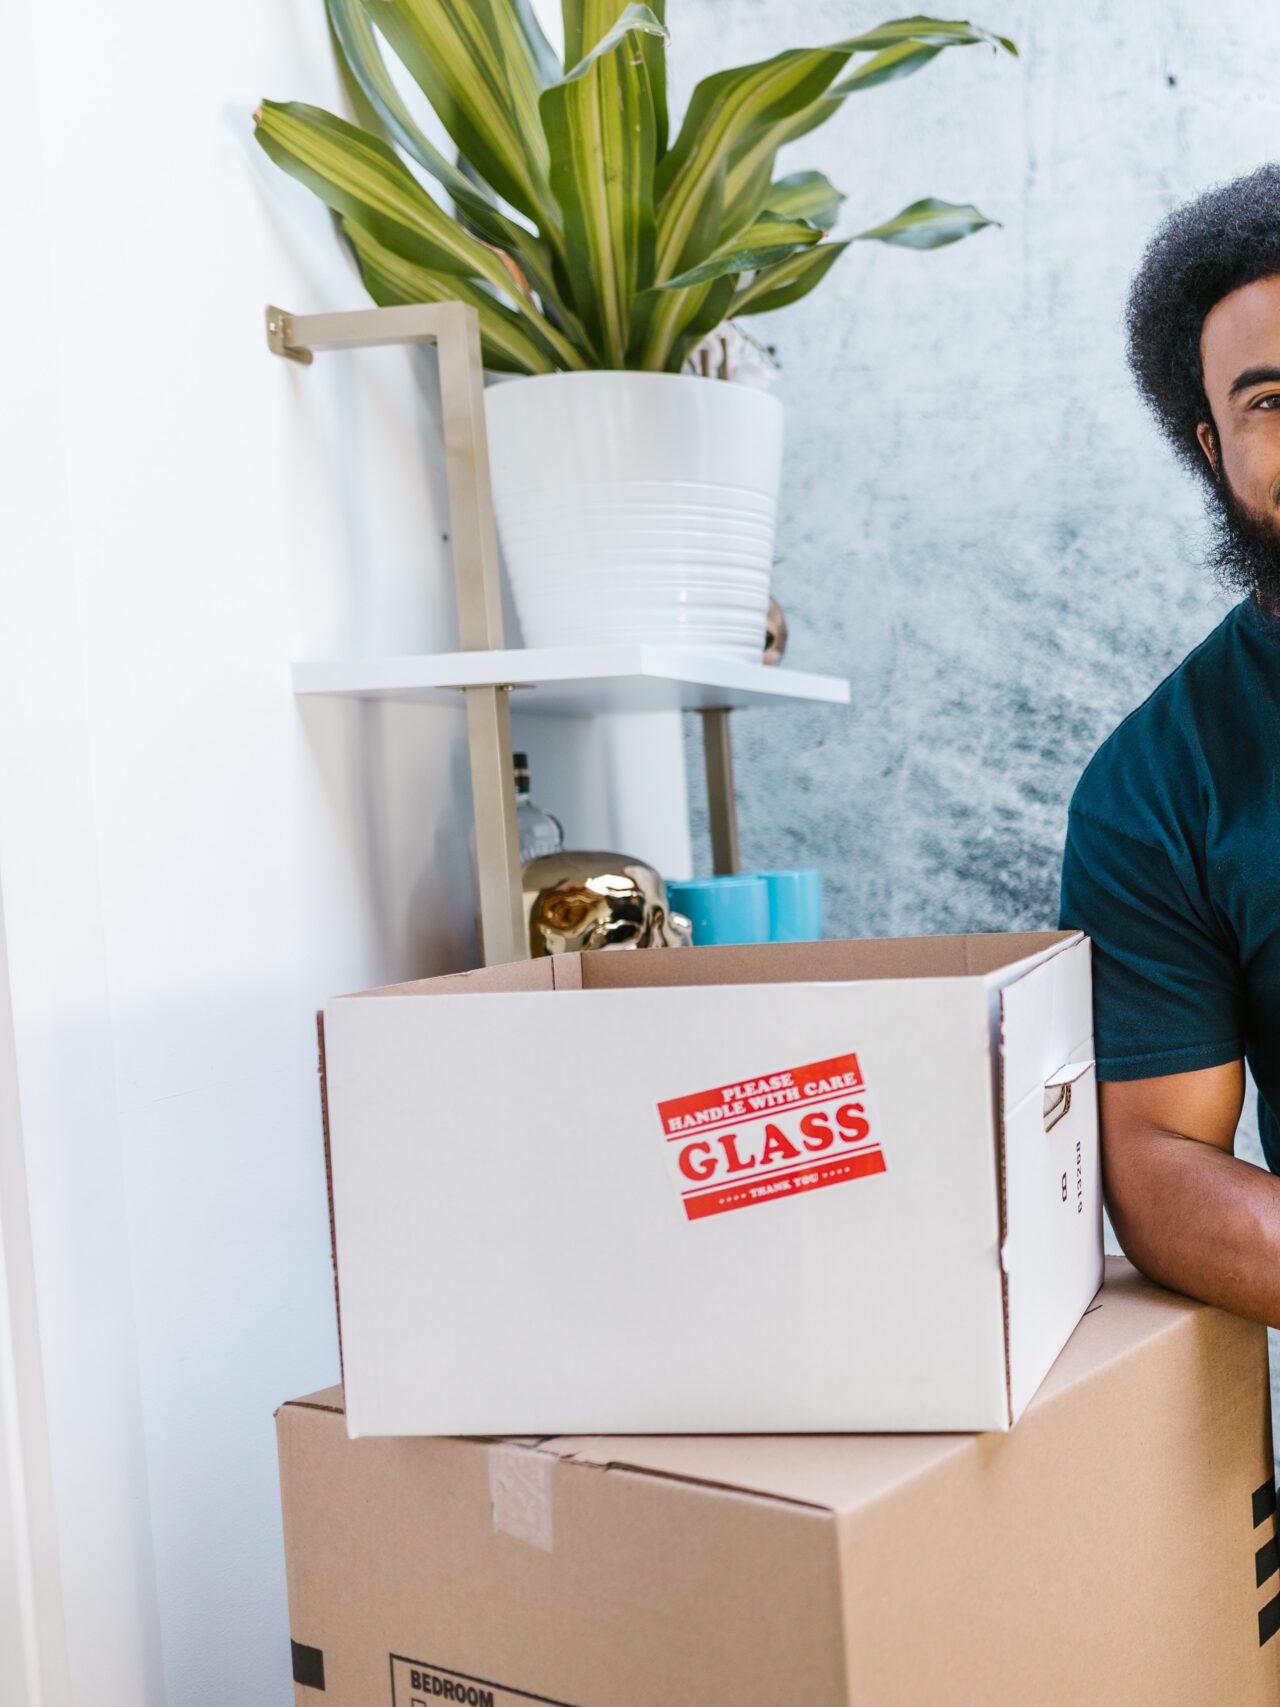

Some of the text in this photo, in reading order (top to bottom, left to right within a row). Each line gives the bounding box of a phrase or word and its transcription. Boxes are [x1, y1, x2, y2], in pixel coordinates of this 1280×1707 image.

[668, 1072, 857, 1131] HANDLE WITH CARE
[722, 1073, 794, 1102] PLEASE
[679, 1102, 870, 1181] GLASS
[749, 1173, 818, 1198] THANK YOU
[410, 1669, 494, 1707] BEDROOM
